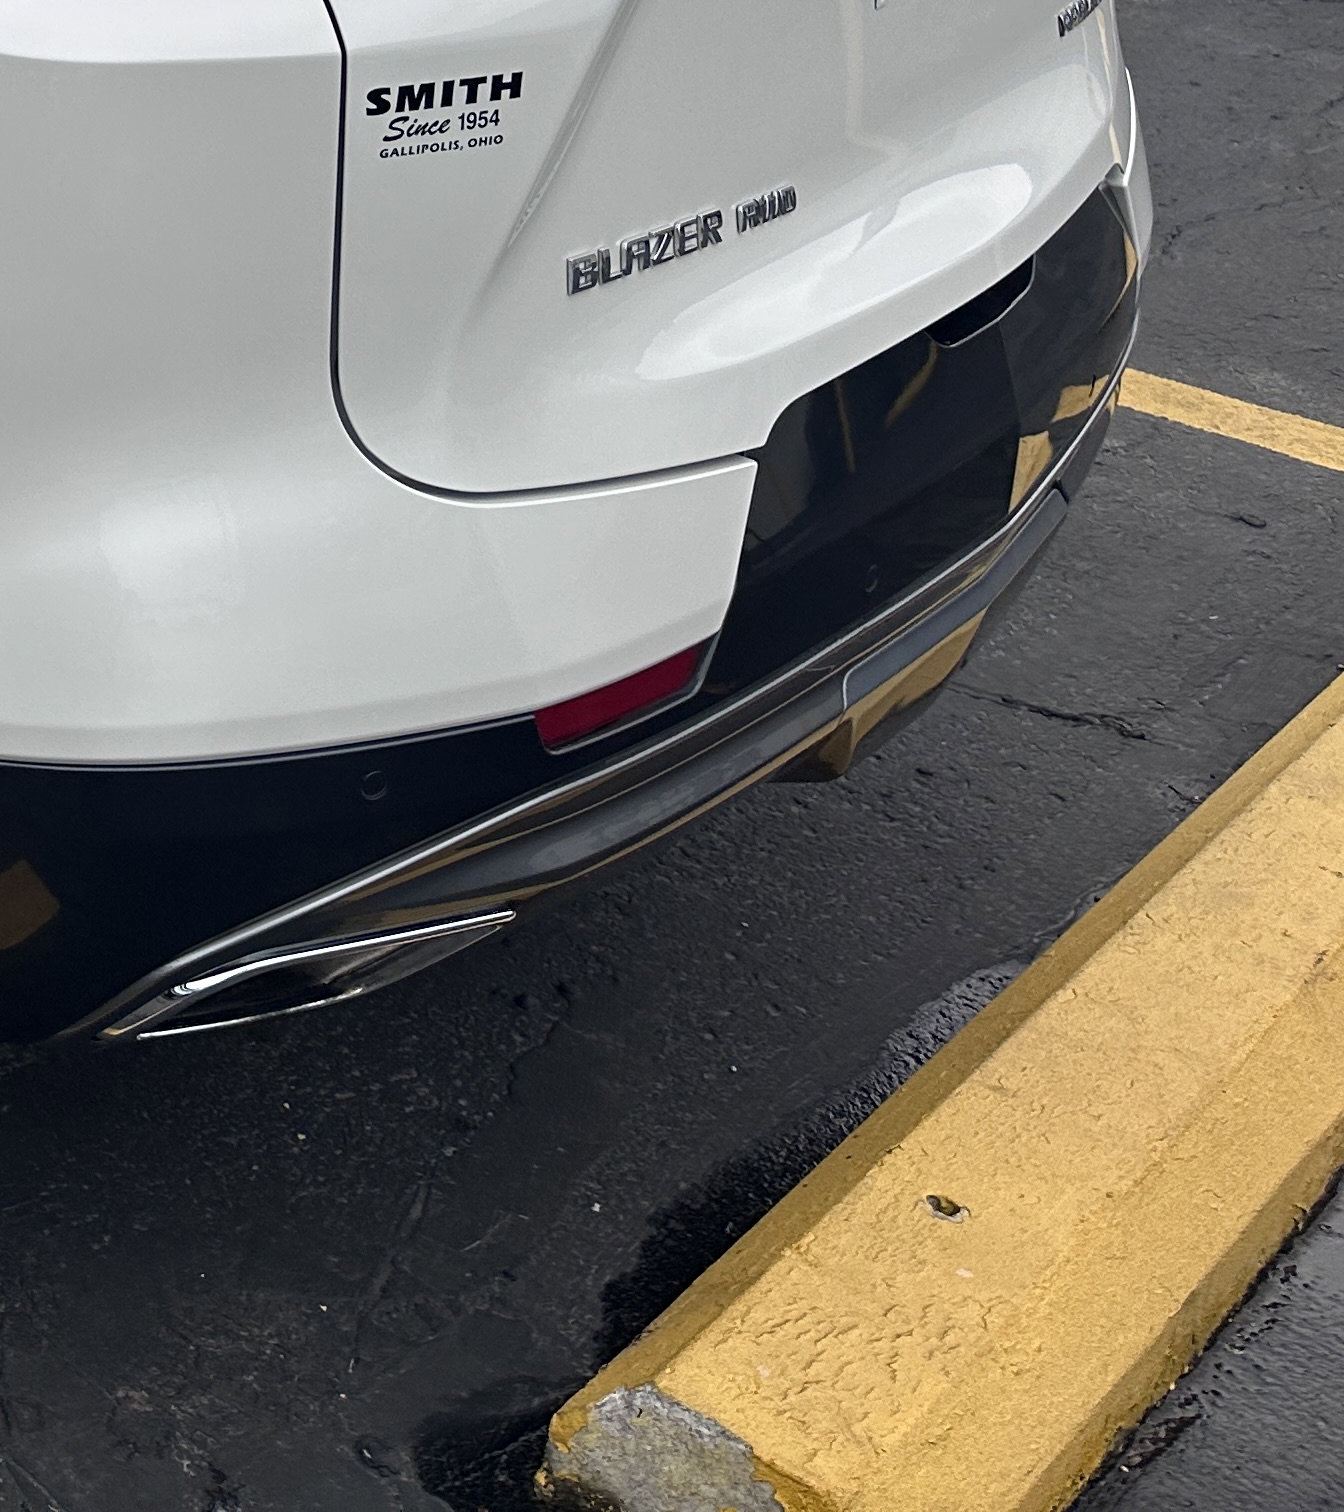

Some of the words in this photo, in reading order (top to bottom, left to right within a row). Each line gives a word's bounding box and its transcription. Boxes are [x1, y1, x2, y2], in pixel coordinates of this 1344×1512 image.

[365, 71, 524, 116] SMITH
[382, 115, 451, 142] Since
[457, 109, 501, 131] 1954
[379, 140, 464, 159] GALLIPOLIS,
[467, 134, 504, 148] OHIO
[566, 209, 723, 295] BLAZER
